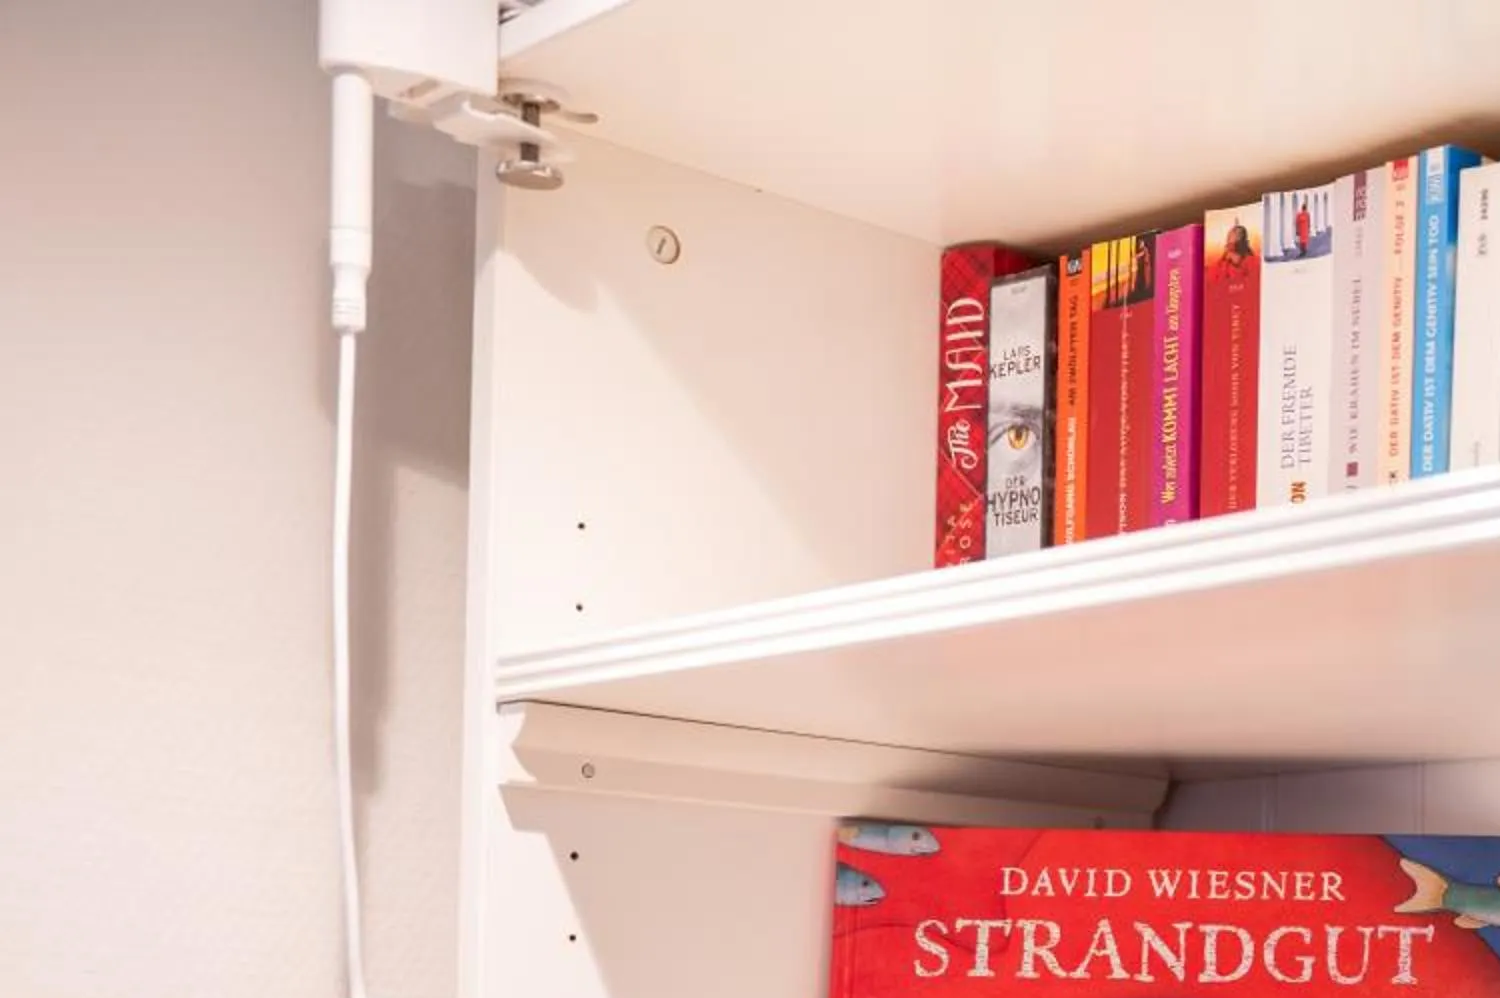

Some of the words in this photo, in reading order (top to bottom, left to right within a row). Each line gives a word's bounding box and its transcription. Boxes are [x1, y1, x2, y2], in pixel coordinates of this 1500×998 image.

[1427, 215, 1440, 246] TOD
[1427, 248, 1438, 279] SEIN
[1425, 284, 1438, 338] GENITIV
[944, 296, 984, 412] MAID
[989, 356, 1041, 379] KEPLER
[1003, 346, 1031, 362] LARS
[1162, 335, 1179, 381] LACHT
[1425, 341, 1436, 373] DEM
[1281, 344, 1297, 426] FREMDE
[1424, 376, 1435, 397] IST
[1161, 386, 1178, 444] KOMMT
[1297, 384, 1314, 465] TIBETER
[1423, 400, 1435, 441] DATIV
[945, 418, 977, 469] The
[1280, 430, 1296, 470] DER
[1422, 445, 1435, 472] DER
[986, 486, 1041, 514] HYPNO
[1005, 477, 1025, 489] DER
[993, 509, 1038, 527] TISEUR
[1000, 866, 1132, 897] DAVID
[1148, 868, 1346, 902] WIESNER
[912, 917, 1436, 986] STRANDGUT
